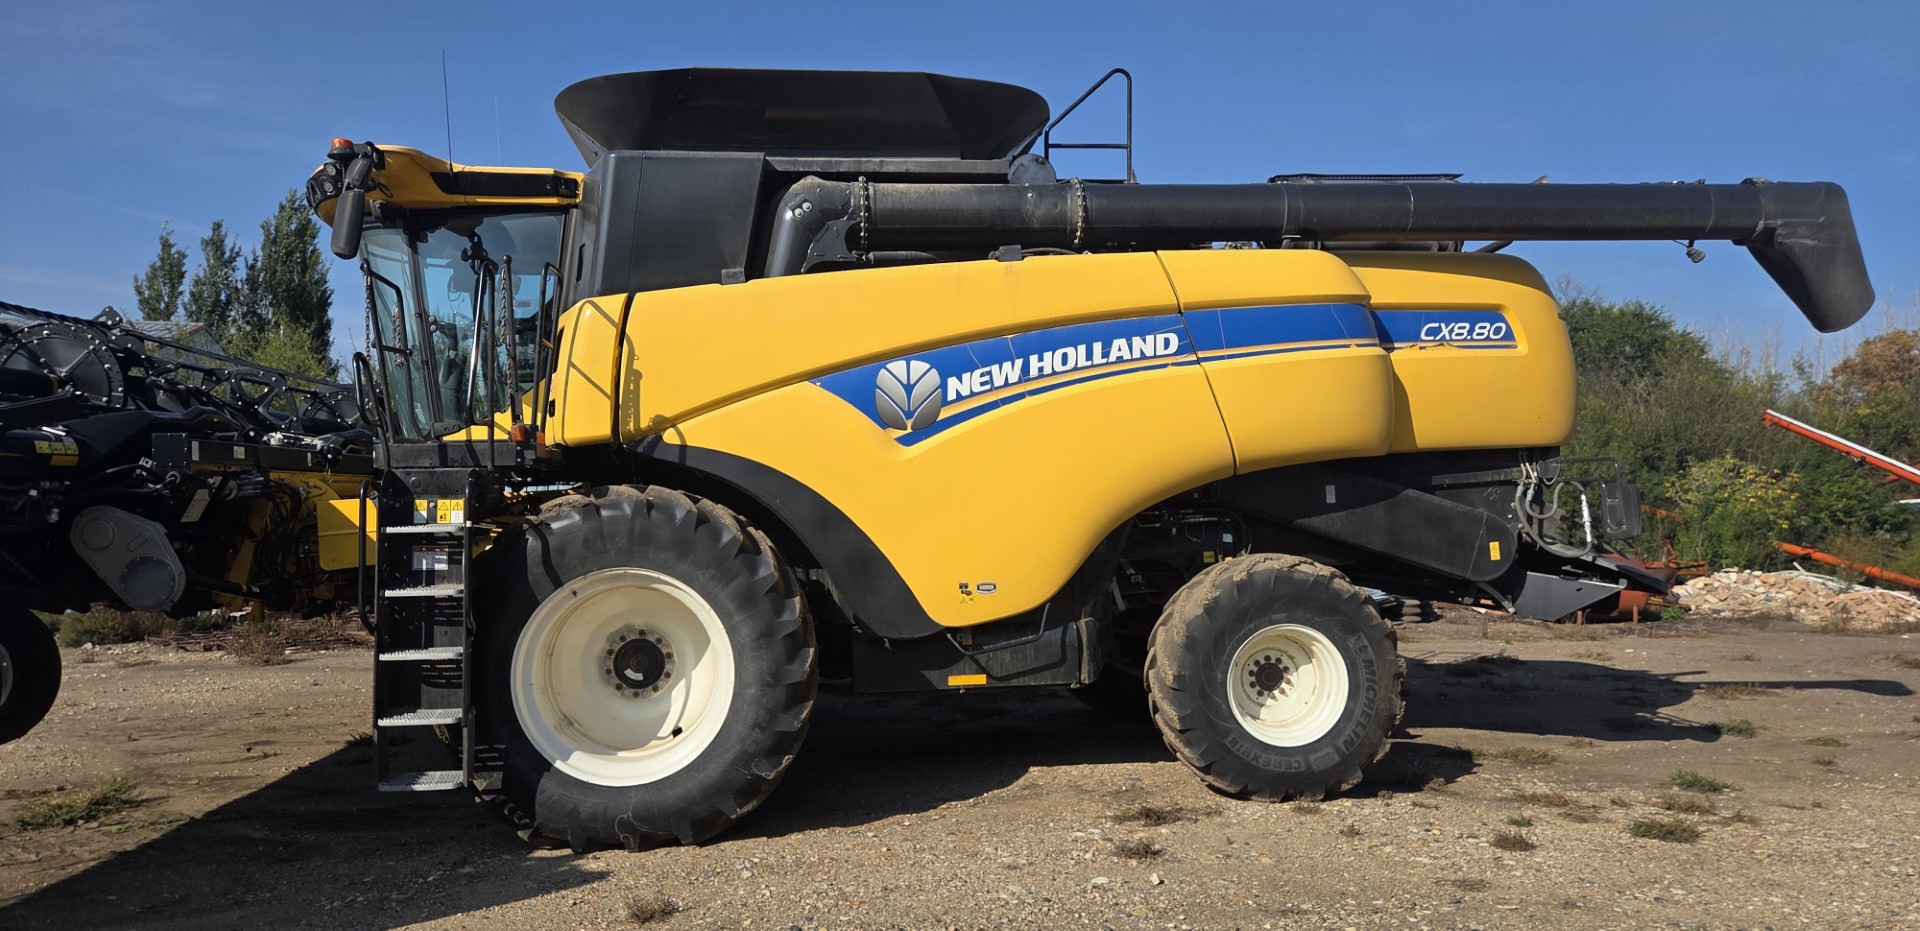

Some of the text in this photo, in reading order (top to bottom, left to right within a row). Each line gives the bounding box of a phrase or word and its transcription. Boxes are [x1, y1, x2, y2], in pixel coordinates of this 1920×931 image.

[1420, 322, 1507, 341] CX8.80
[947, 332, 1179, 401] NEW HOLLAND
[1342, 659, 1377, 754] MICHELIN
[1228, 736, 1302, 771] CEREXBIB
